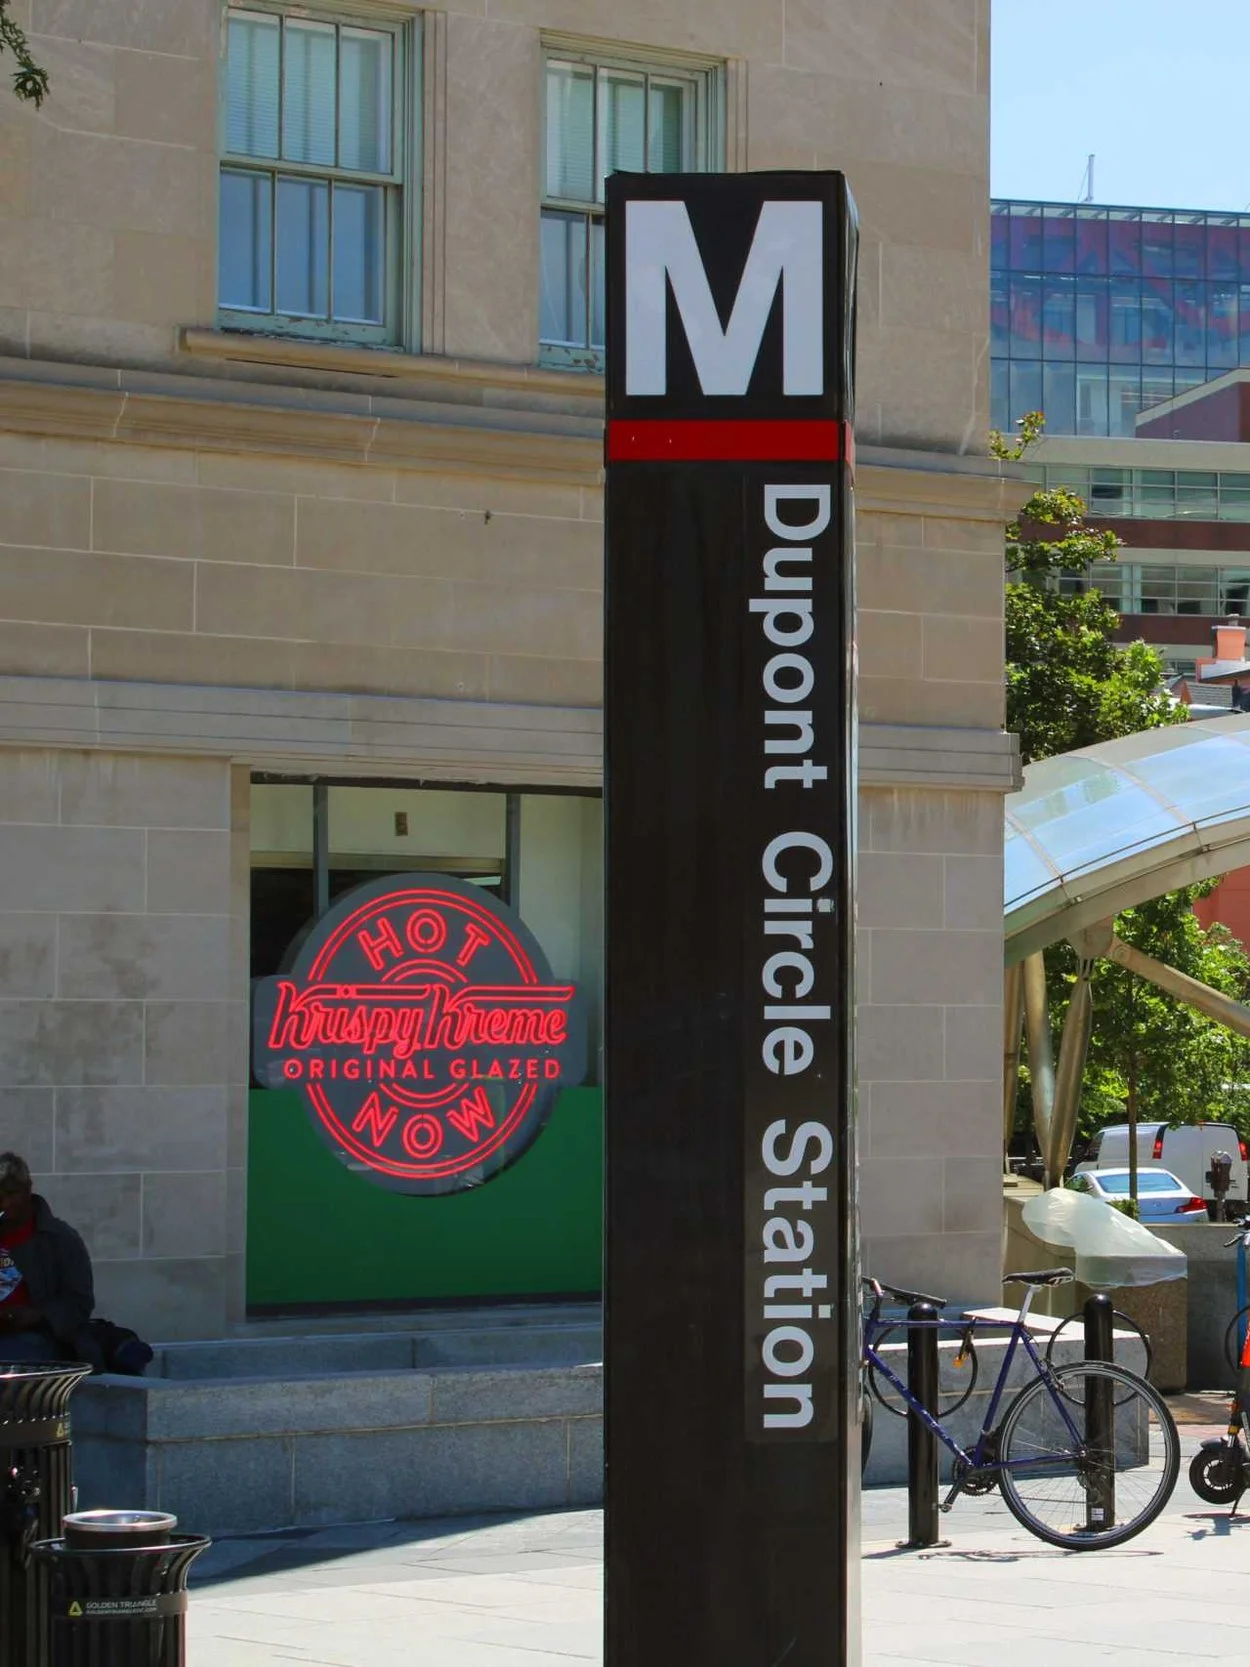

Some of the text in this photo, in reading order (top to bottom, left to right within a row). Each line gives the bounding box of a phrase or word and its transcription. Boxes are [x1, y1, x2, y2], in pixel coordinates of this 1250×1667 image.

[625, 200, 824, 396] M
[356, 907, 491, 971] HOT
[748, 483, 835, 1429] Dupont Circle Station
[267, 981, 576, 1060] Krispy Kreme
[283, 1058, 562, 1080] ORIGINAL GLAZED
[351, 1085, 496, 1159] NOW
[86, 1599, 157, 1609] GOLDEN TRIANGLE
